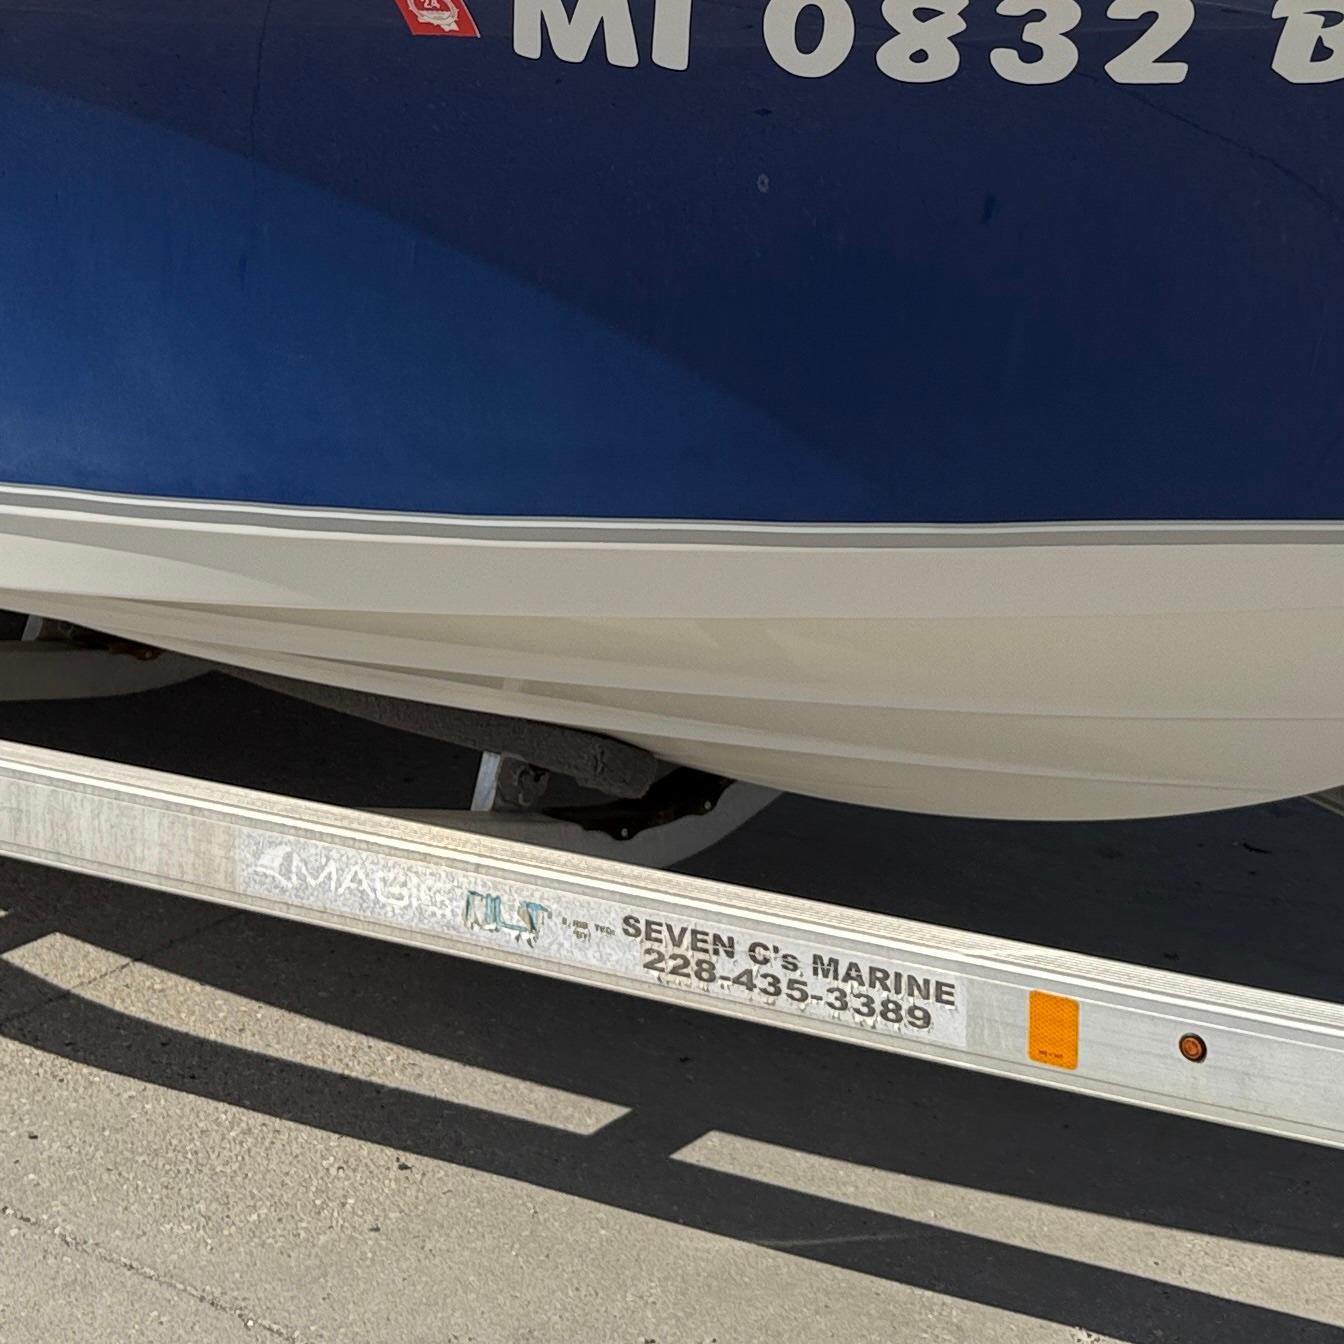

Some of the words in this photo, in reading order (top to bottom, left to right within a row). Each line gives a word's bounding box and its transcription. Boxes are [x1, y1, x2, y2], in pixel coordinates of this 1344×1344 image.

[622, 914, 736, 960] SEVEN
[748, 941, 801, 974] C's
[812, 953, 957, 1007] MARINE
[643, 947, 931, 1030] 228-435-3389
